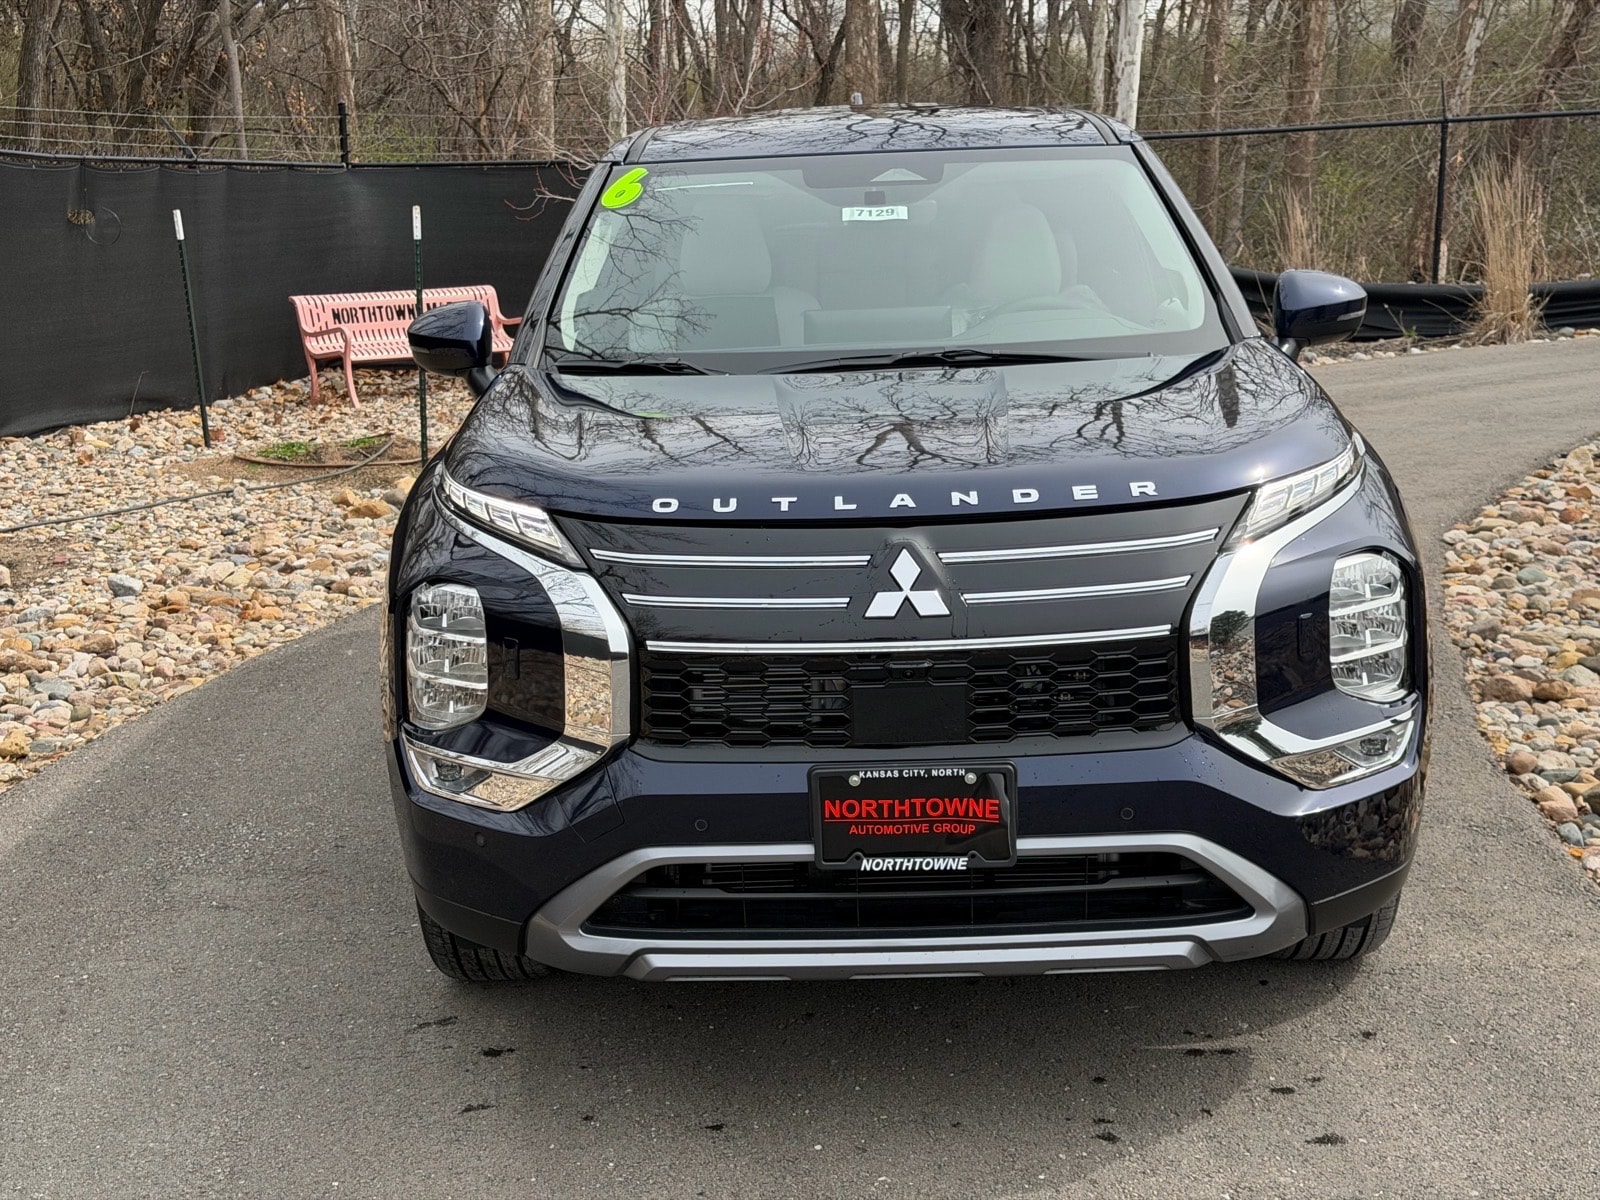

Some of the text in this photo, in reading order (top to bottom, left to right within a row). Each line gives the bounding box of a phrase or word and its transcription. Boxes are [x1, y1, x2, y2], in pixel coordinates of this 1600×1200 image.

[601, 167, 649, 209] 6
[855, 208, 895, 218] 7129
[332, 303, 422, 325] NORTHTOWN
[652, 481, 1158, 512] OUTLANDER
[859, 768, 966, 779] KANSAS CITY, NORTH
[824, 799, 999, 818] NORTHTOWNE
[849, 822, 976, 835] AUTOMOTIVE GROUP
[860, 857, 969, 872] NORTHTOWNE
